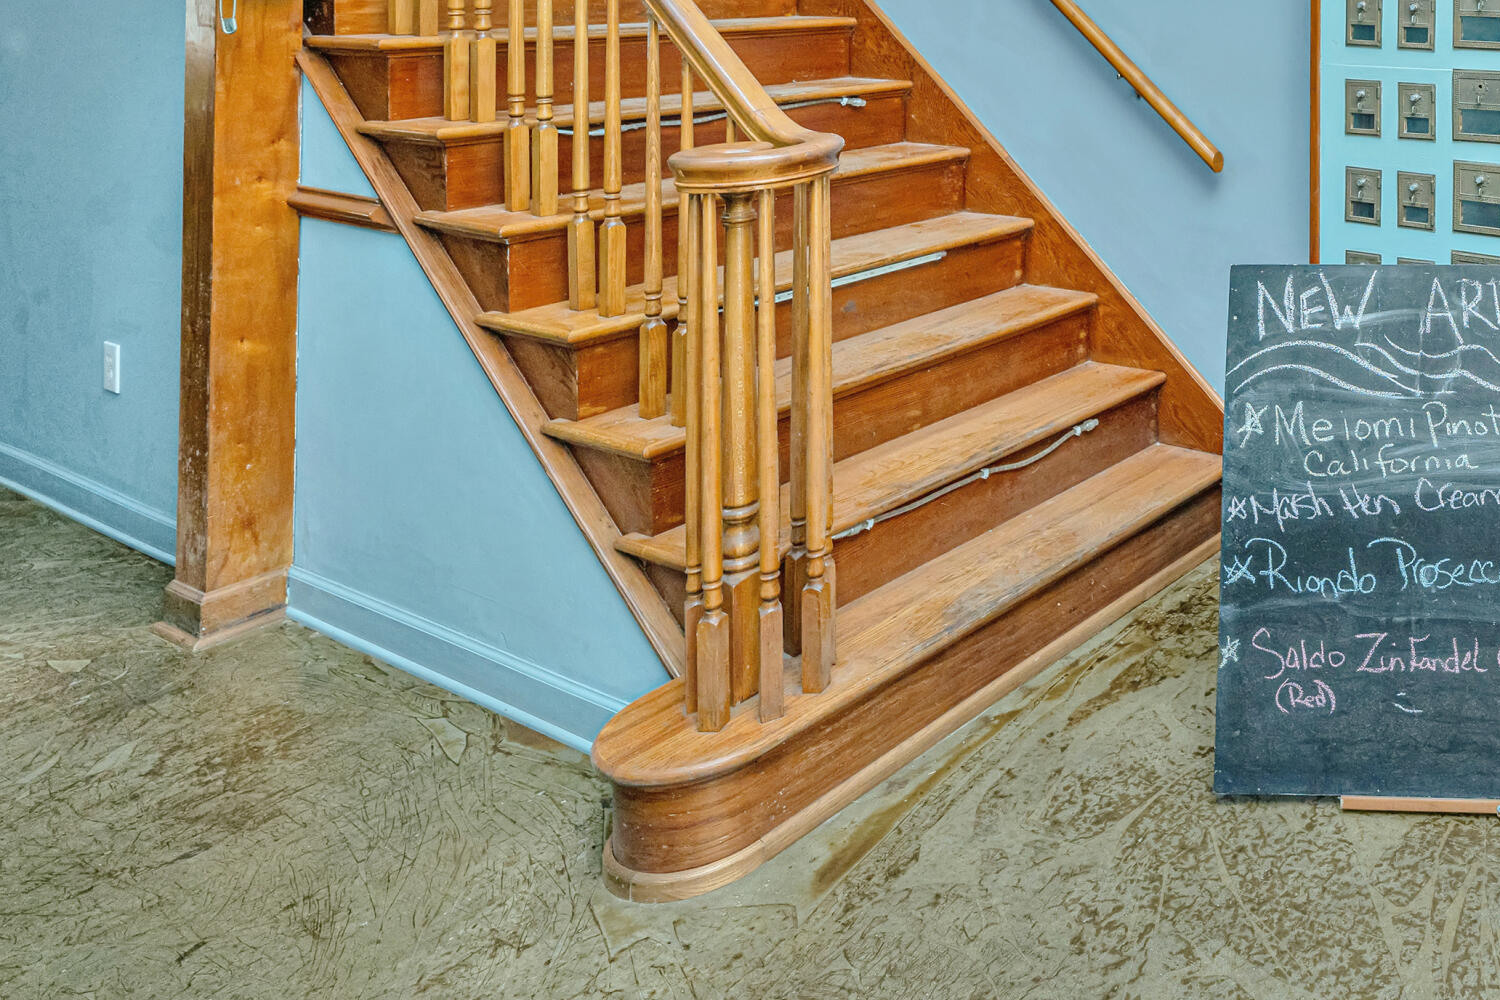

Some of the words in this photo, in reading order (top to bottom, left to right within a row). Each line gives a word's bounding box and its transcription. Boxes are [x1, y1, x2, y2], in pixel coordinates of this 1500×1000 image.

[1256, 269, 1378, 341] NEW
[1303, 442, 1479, 479] California
[1244, 537, 1377, 599] Riondo
[1251, 627, 1346, 680] Saldo
[1275, 678, 1337, 715] (Red)
